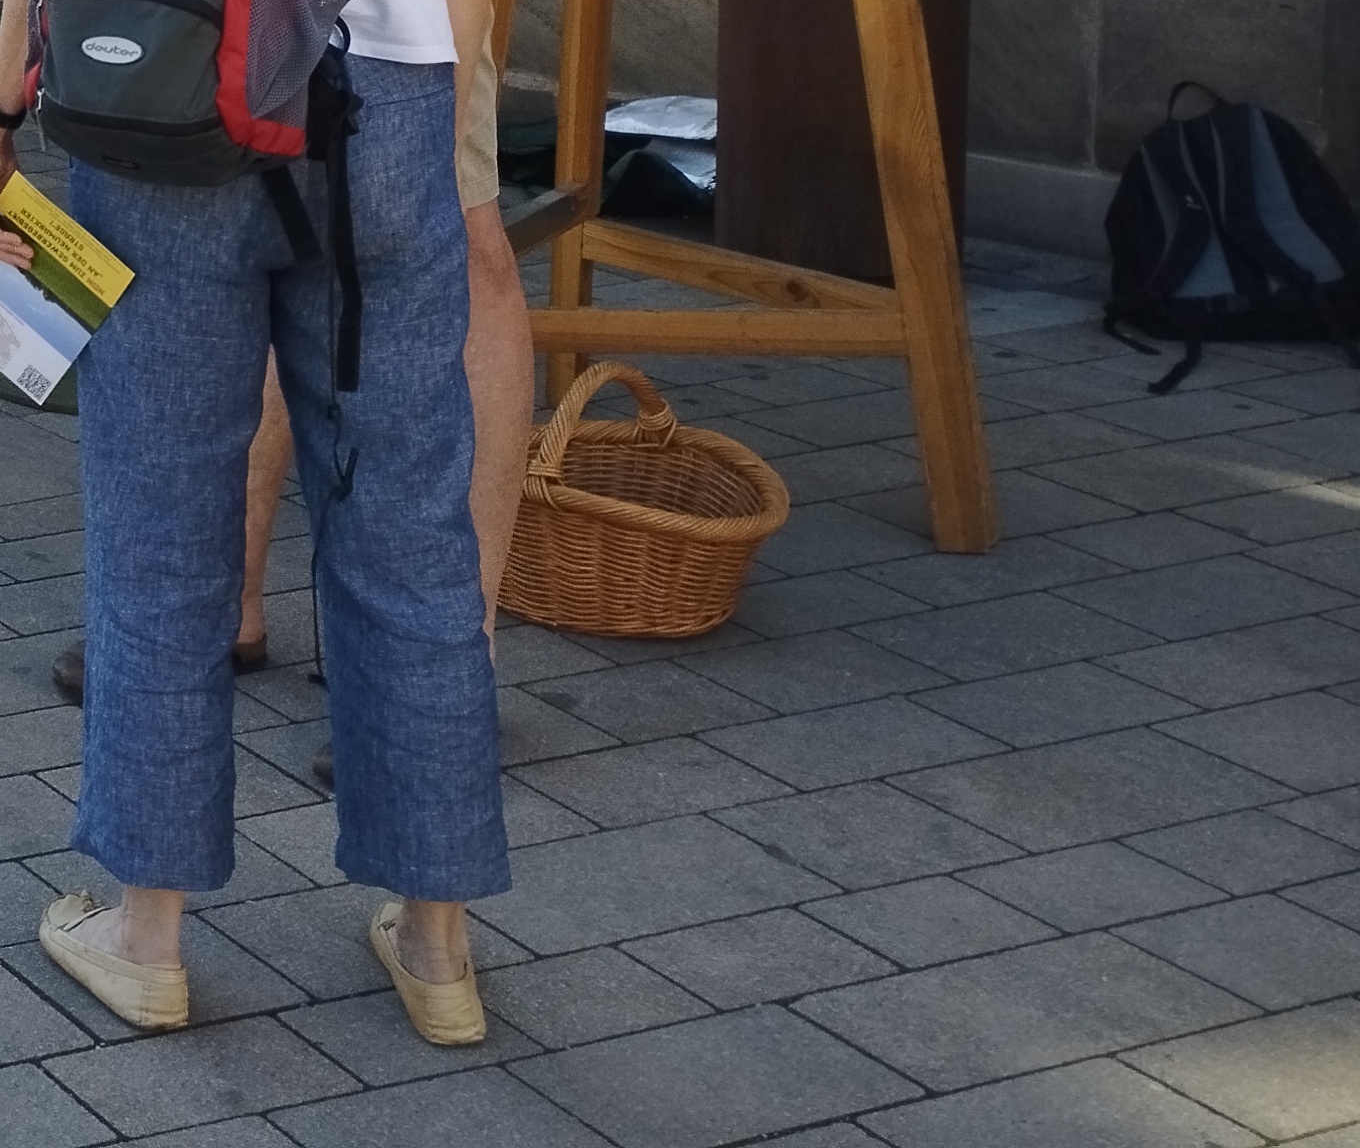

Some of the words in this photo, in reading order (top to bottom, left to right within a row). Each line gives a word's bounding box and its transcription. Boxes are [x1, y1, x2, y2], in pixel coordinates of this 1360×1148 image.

[84, 42, 140, 59] deuter
[70, 251, 88, 267] DER
[68, 262, 87, 278] ZUM
